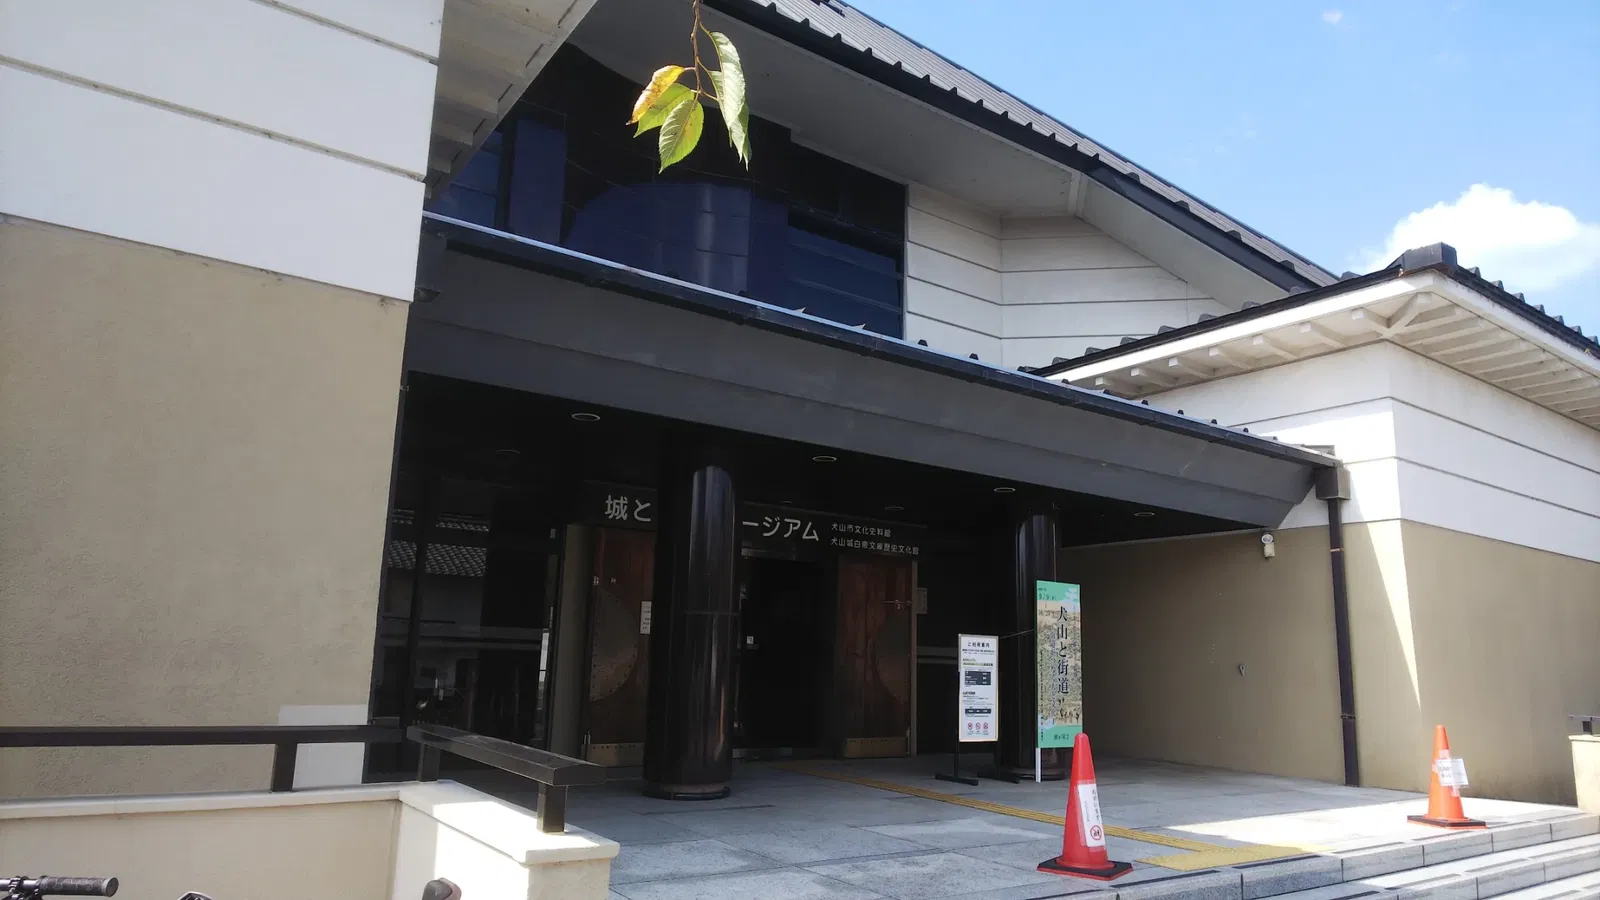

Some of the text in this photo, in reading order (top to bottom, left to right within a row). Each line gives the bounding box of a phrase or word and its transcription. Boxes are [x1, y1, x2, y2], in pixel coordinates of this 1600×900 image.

[830, 522, 892, 538] 犬山市文化史料館
[1057, 605, 1069, 694] 犬山と街道
